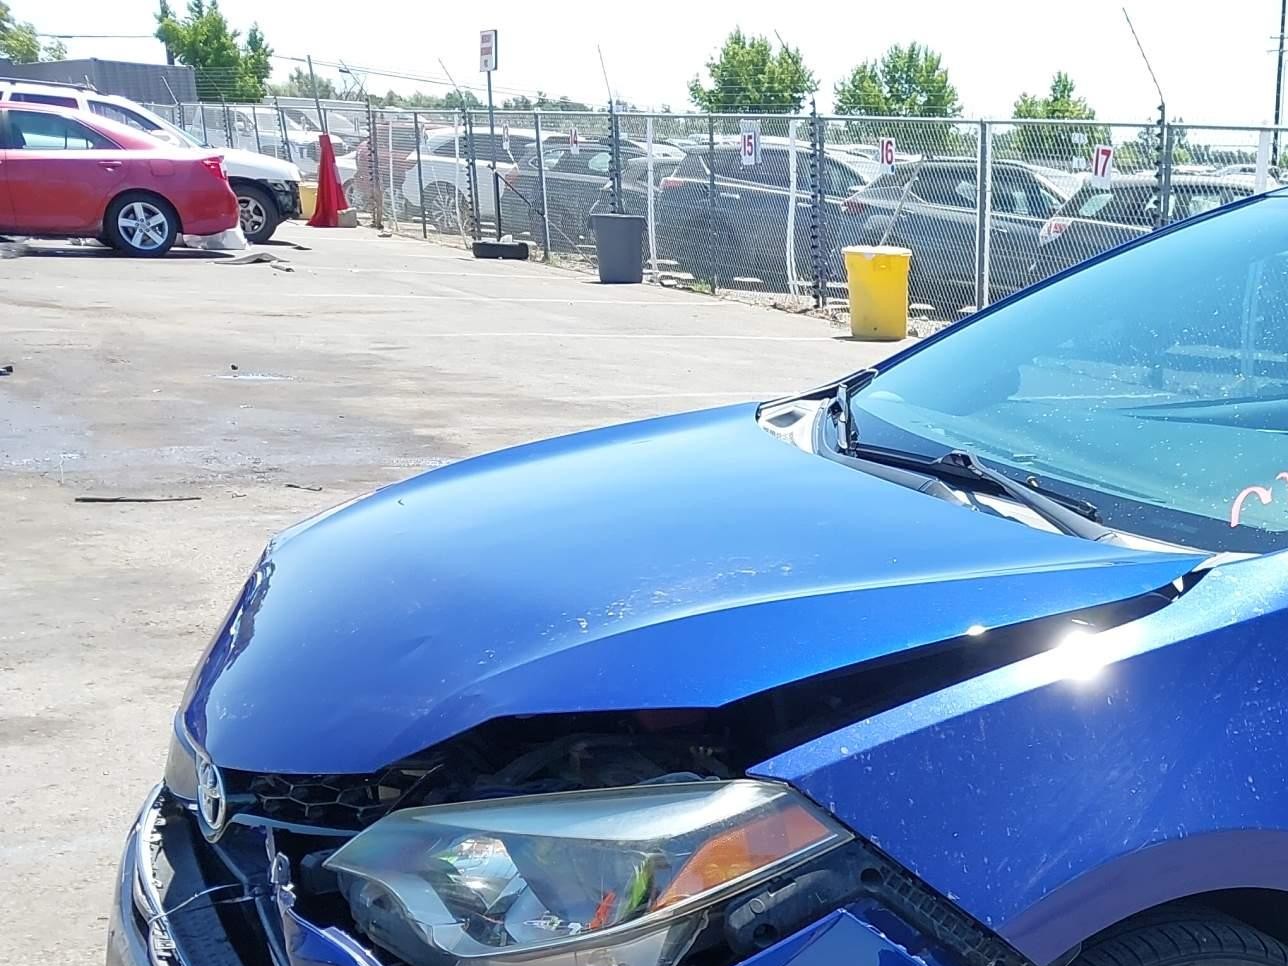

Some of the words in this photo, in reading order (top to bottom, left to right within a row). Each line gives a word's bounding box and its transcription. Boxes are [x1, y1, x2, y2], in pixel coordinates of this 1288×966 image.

[743, 134, 754, 156] 15
[881, 139, 894, 165] 16
[1094, 147, 1111, 177] 17
